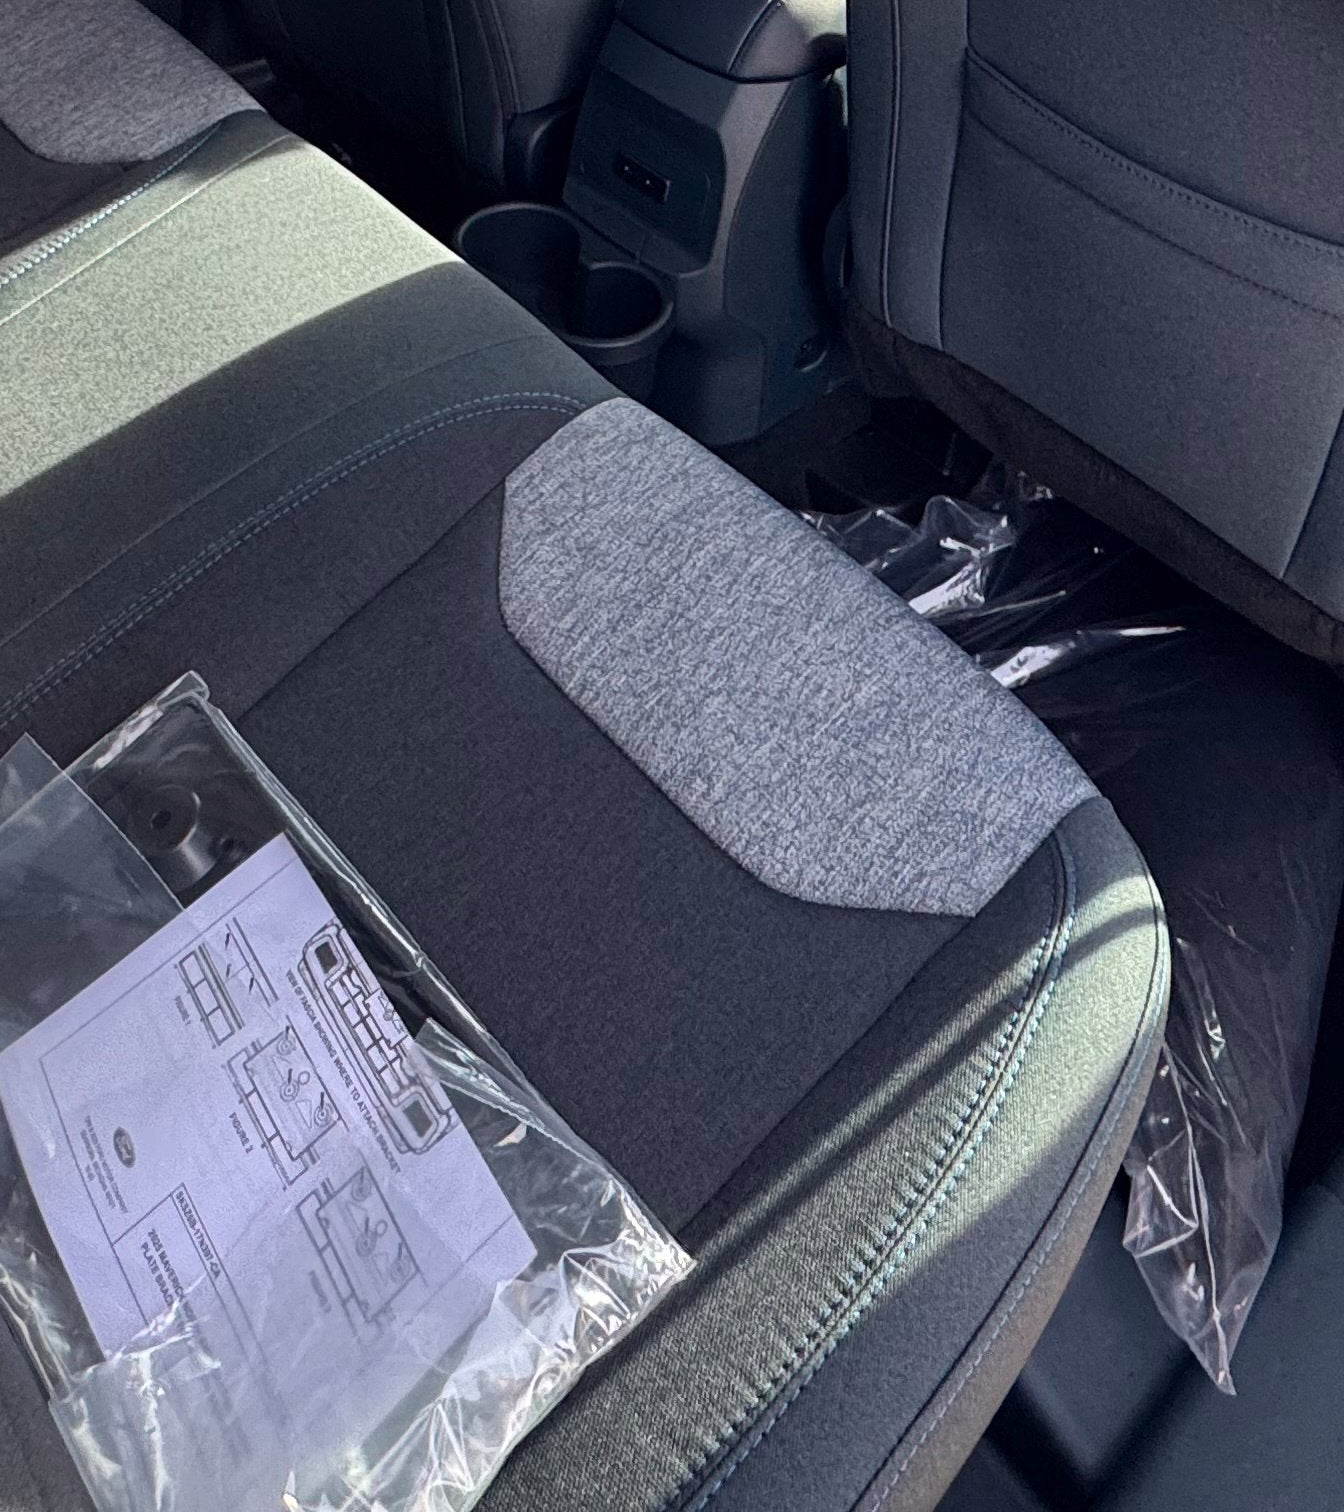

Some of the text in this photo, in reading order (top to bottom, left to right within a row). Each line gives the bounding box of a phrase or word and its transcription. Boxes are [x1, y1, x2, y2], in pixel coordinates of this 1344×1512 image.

[229, 1112, 250, 1146] FIGURE
[333, 1057, 353, 1088] WHERE
[349, 1087, 361, 1101] TO
[357, 1100, 379, 1135] ATTACH
[375, 1134, 401, 1174] BRACKET
[141, 1241, 160, 1275] PLATE
[158, 1250, 185, 1302] MAVERICK
